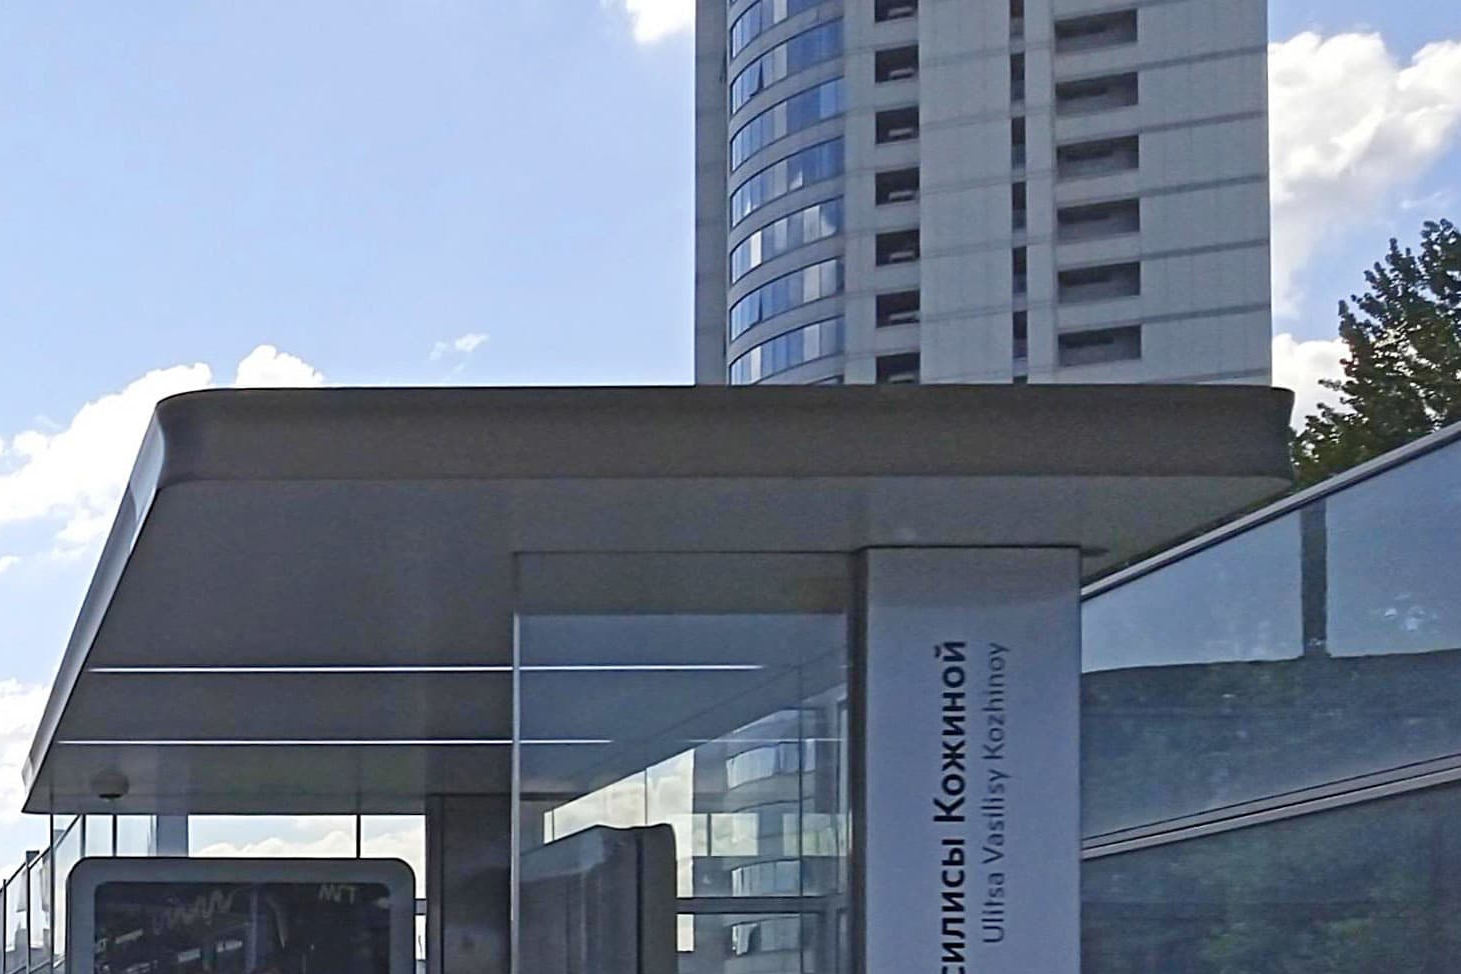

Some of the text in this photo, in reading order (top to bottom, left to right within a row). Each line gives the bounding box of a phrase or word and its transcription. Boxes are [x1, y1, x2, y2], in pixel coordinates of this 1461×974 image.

[933, 641, 967, 823] Кожиной
[982, 642, 1012, 945] Ulitsa Vasilisy Kozhinoy
